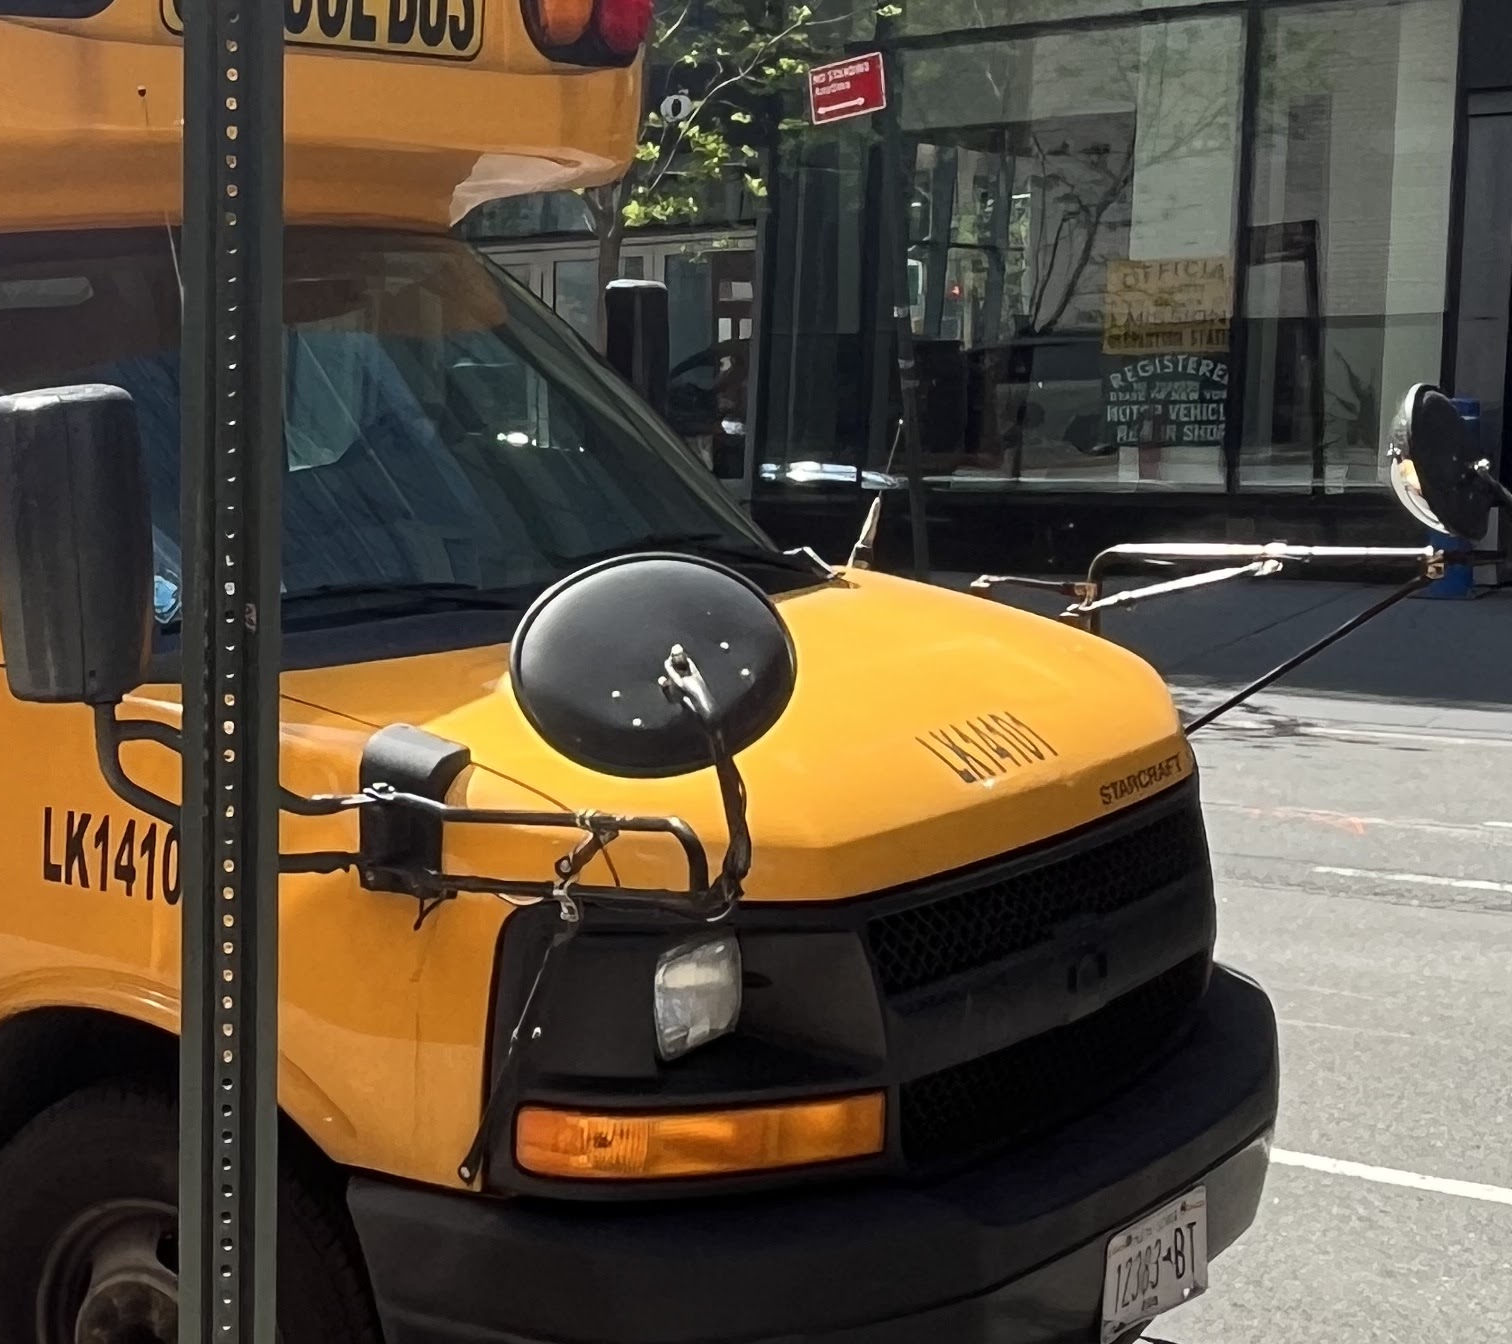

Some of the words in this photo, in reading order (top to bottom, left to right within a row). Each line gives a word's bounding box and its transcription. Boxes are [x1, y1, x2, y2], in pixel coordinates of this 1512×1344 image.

[1110, 354, 1229, 388] REGISTERE
[1168, 403, 1226, 422] VEHICL
[1099, 751, 1184, 806] STARCRAFT
[43, 806, 183, 905] LK1410
